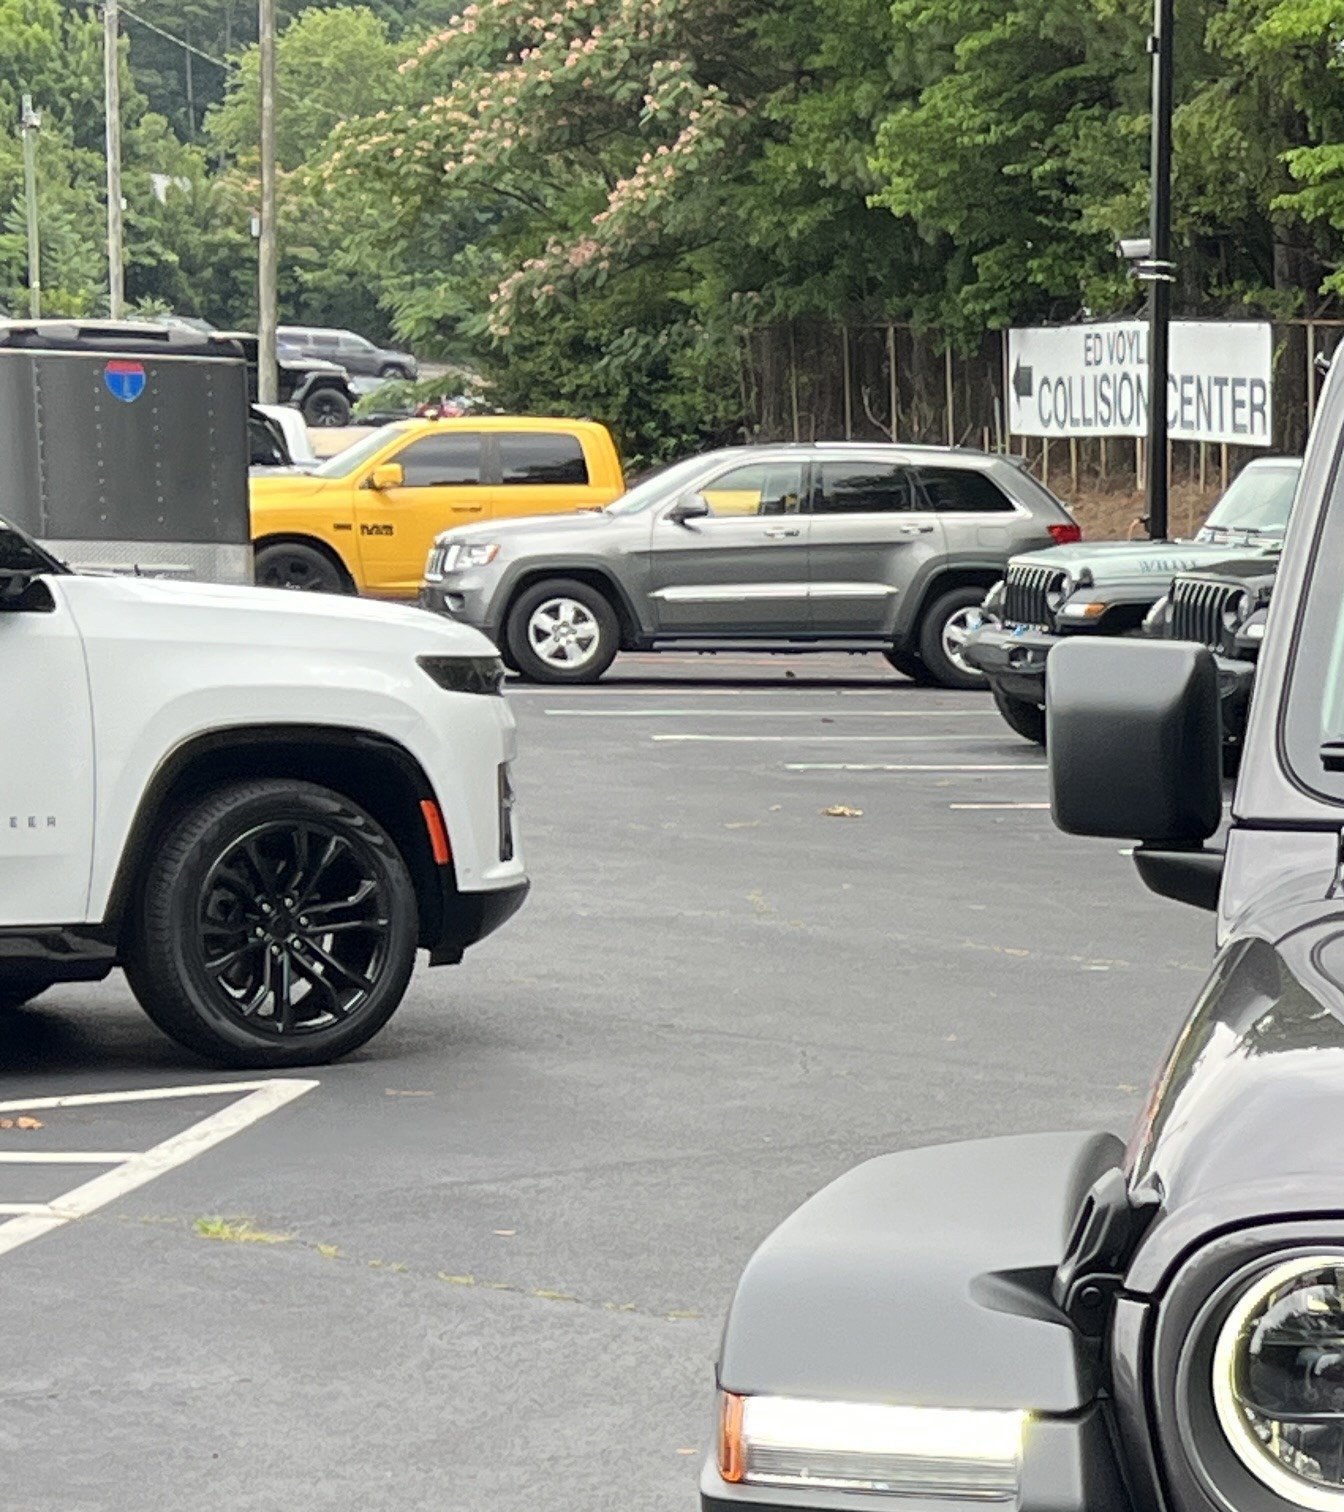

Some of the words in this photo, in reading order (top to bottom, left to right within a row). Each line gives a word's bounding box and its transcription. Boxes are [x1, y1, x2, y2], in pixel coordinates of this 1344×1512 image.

[1084, 333, 1103, 367] ED
[1107, 329, 1150, 366] VOYL
[1037, 372, 1150, 430] COLLISION
[1167, 374, 1267, 436] CENTER
